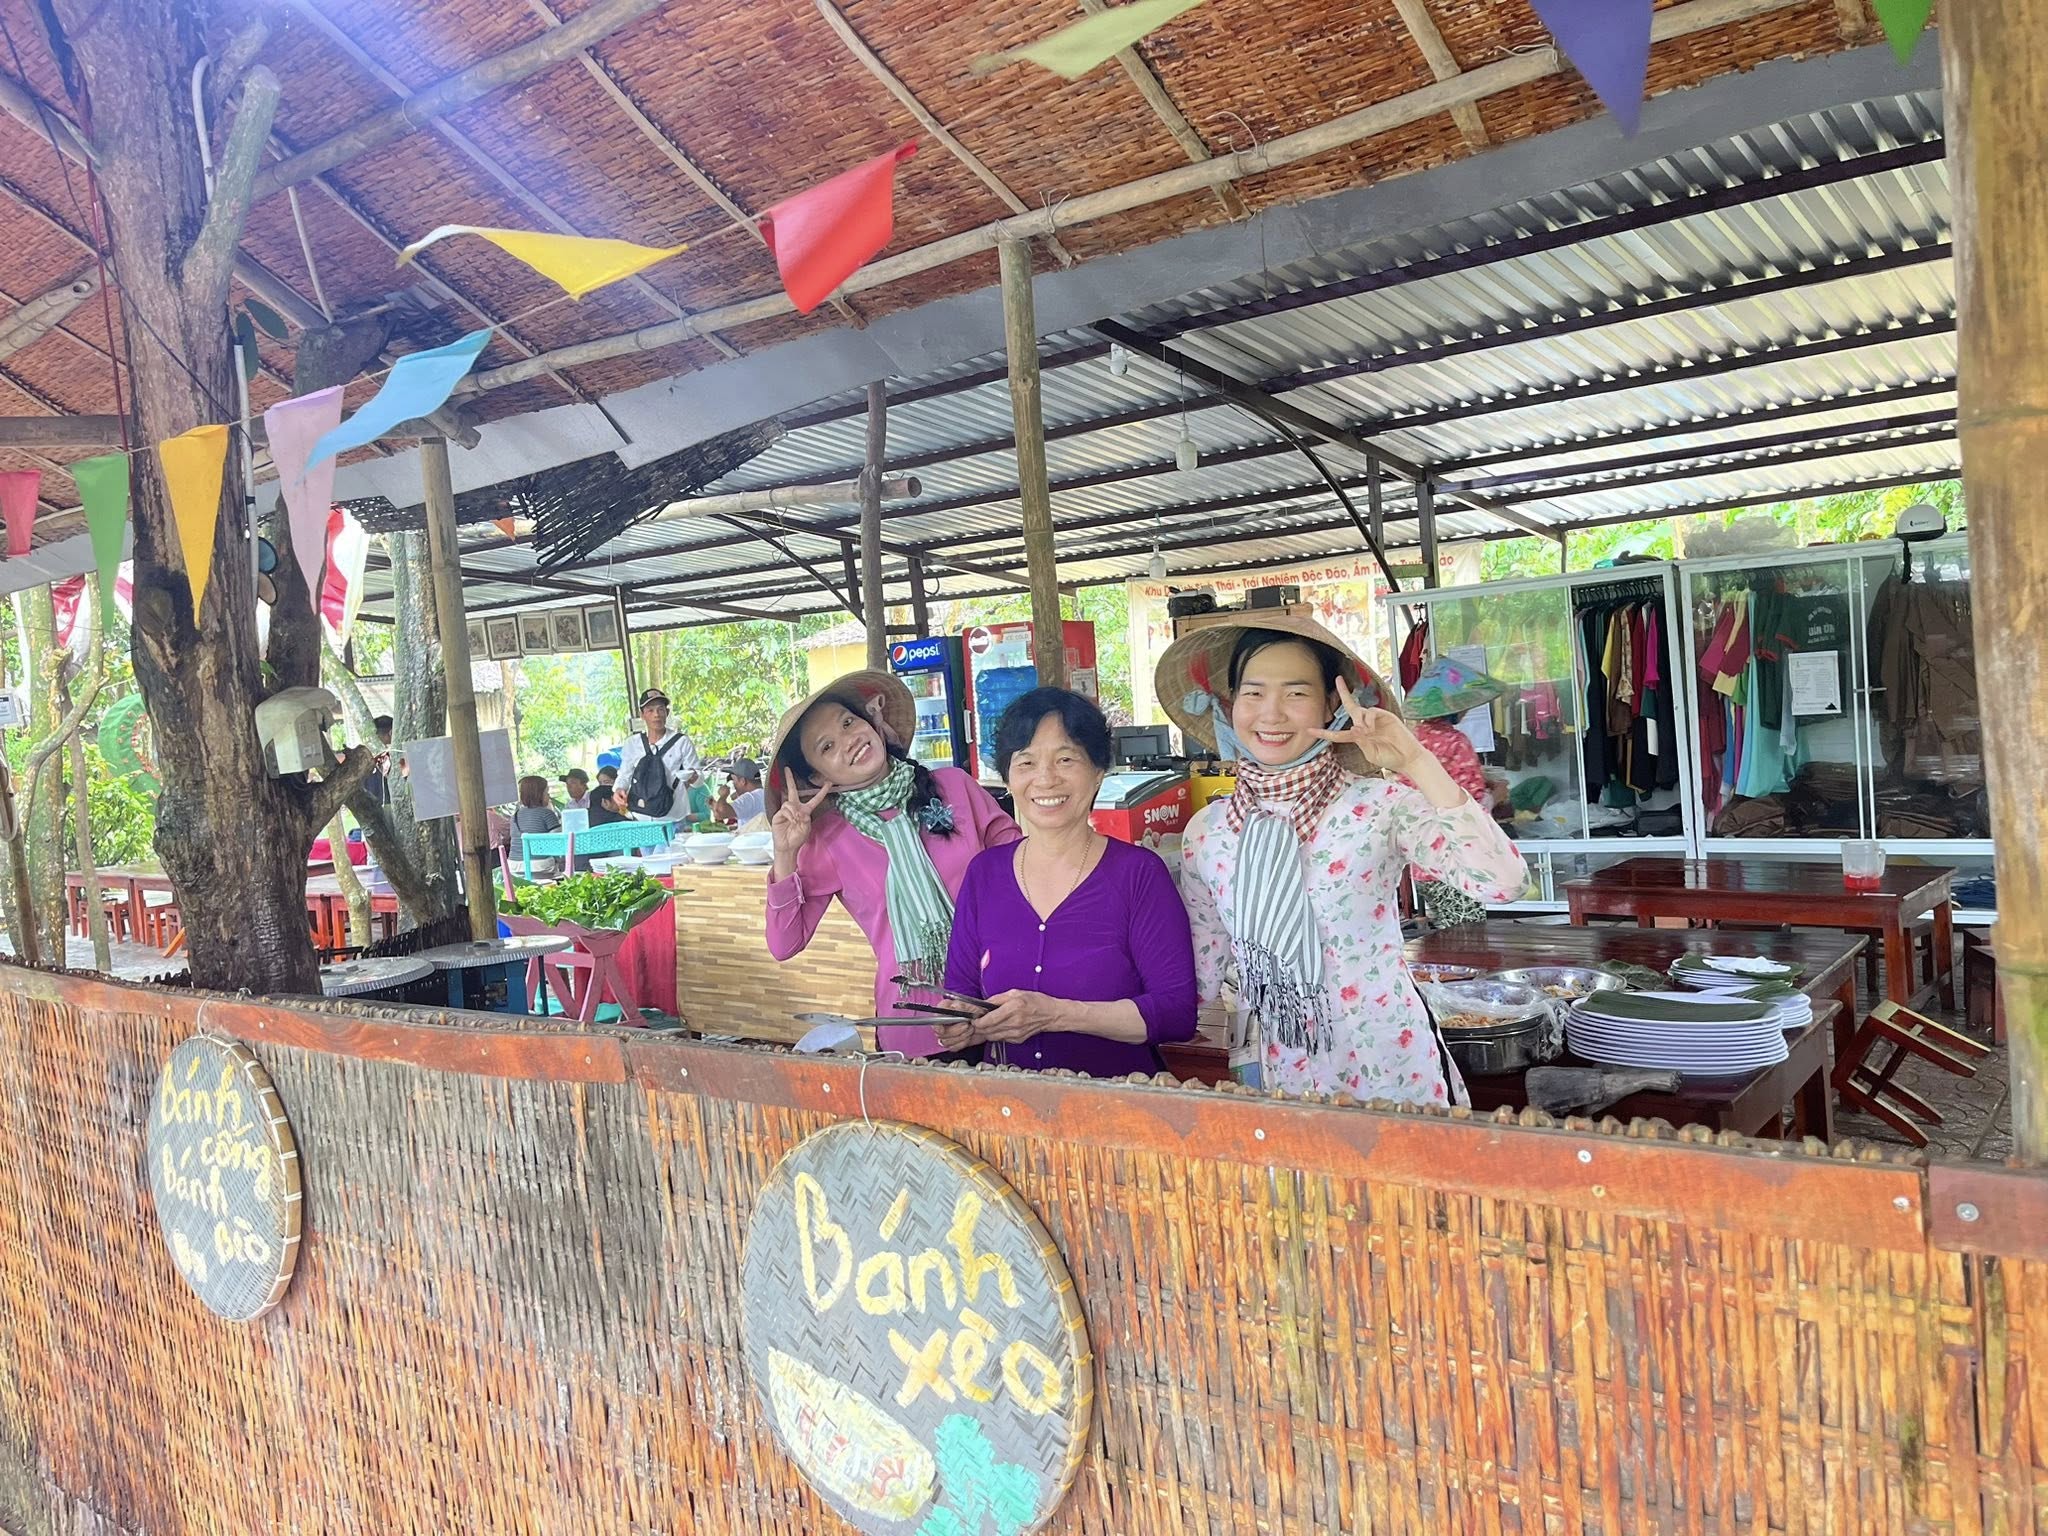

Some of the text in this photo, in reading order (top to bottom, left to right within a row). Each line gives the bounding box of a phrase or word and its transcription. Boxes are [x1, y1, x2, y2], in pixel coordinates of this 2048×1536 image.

[1145, 585, 1162, 597] Khu
[908, 643, 940, 662] pepsi
[1144, 804, 1180, 824] SNOW
[794, 1171, 1024, 1315] Bánh
[888, 1308, 1064, 1416] xèo
